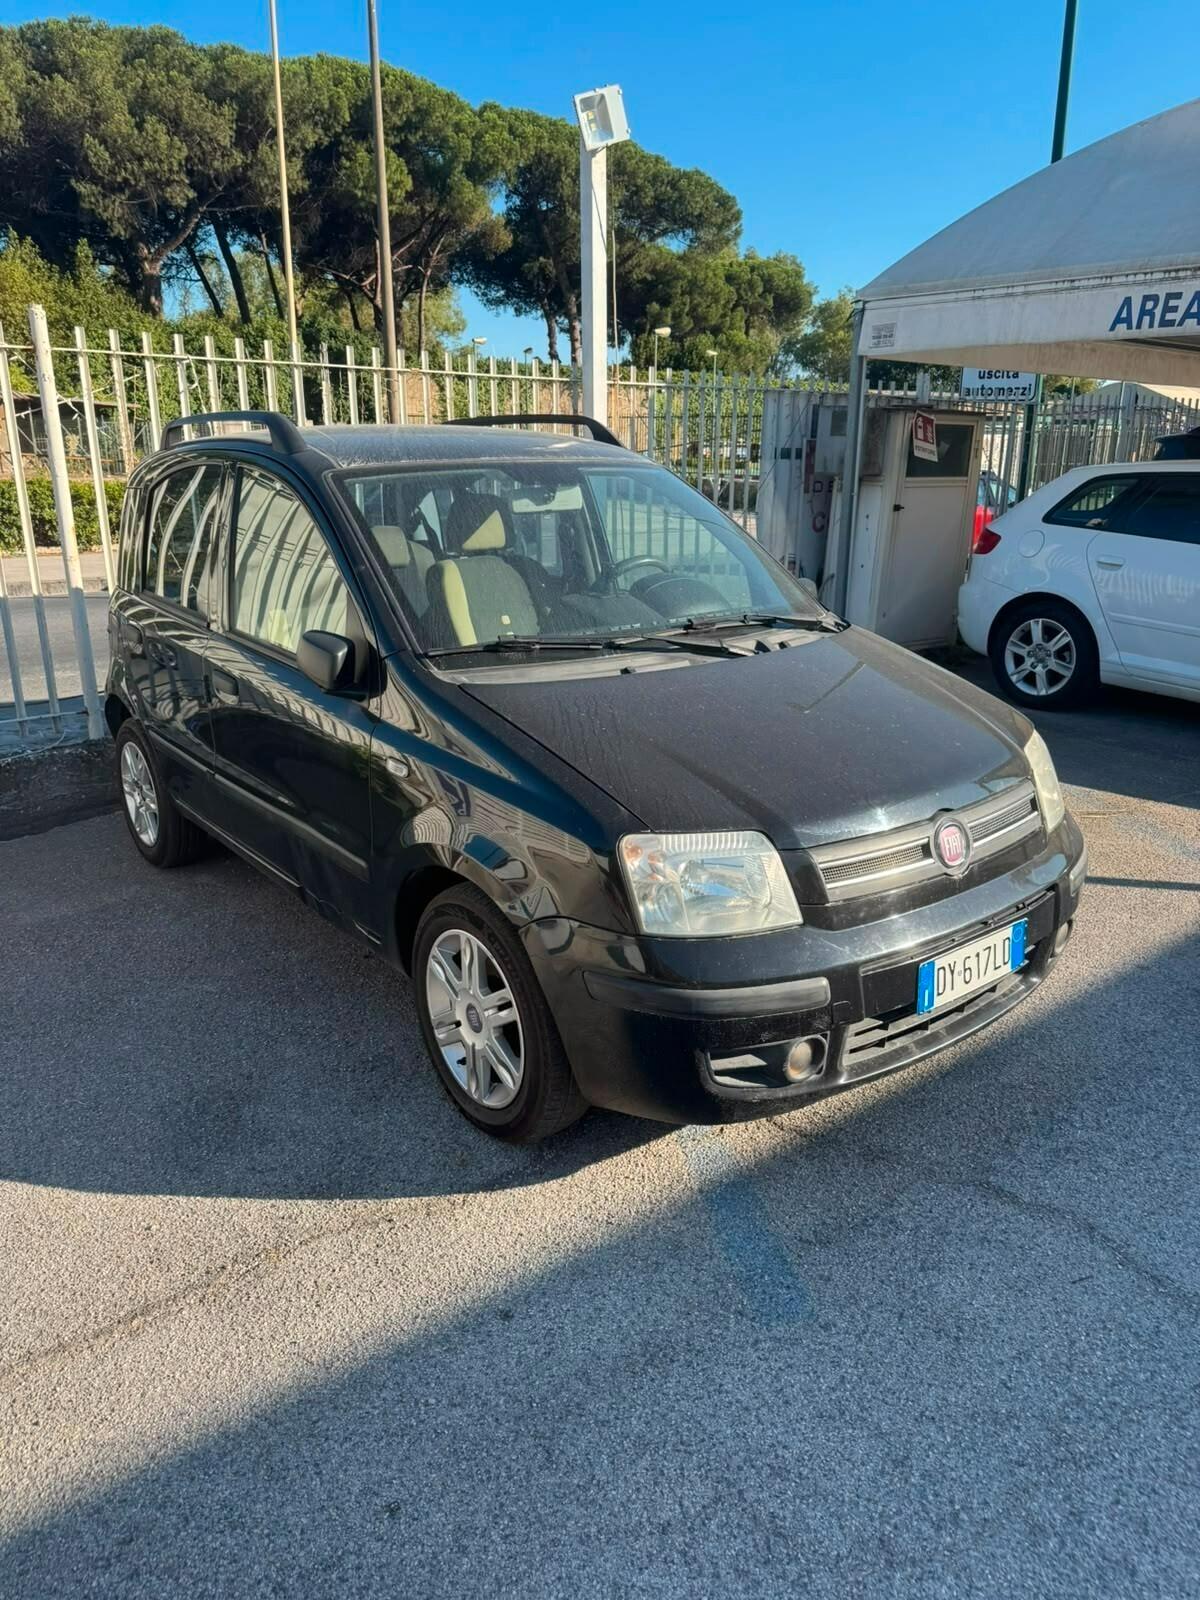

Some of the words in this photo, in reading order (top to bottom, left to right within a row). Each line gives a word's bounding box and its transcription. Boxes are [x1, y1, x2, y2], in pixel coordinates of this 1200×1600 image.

[1108, 290, 1200, 332] AREA
[964, 383, 1032, 396] automezzi
[943, 831, 961, 856] FIAT
